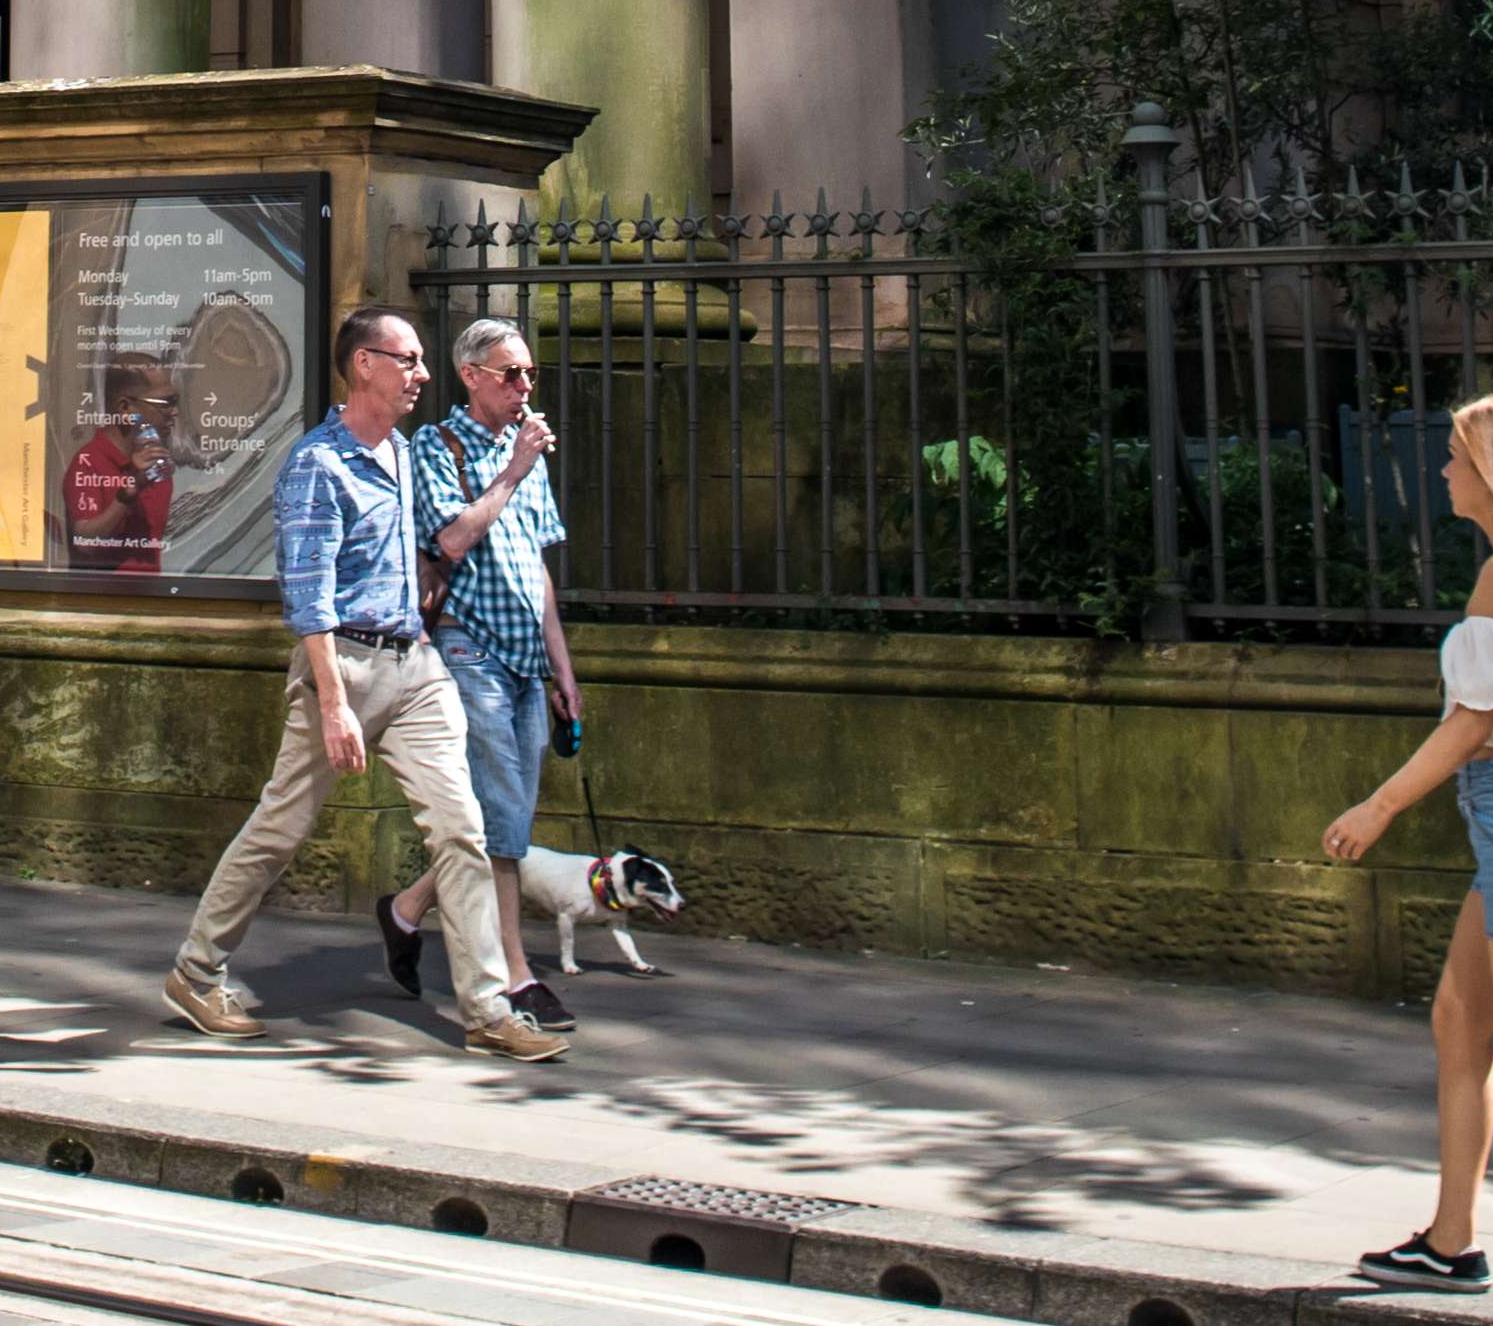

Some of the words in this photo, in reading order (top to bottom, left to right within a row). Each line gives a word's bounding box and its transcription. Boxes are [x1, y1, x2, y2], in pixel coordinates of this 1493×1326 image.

[78, 232, 108, 248] Free
[112, 230, 140, 247] and
[144, 232, 183, 250] open
[187, 231, 203, 246] to
[207, 229, 224, 246] all
[78, 269, 129, 287] Monday
[203, 268, 272, 286] 11am-5pm
[202, 291, 274, 308] 10am-5pm
[97, 325, 152, 338] Wednesday
[153, 324, 165, 336] of
[76, 410, 137, 426] Entrance
[200, 435, 265, 452] Entrance
[22, 442, 31, 495] Manchester
[75, 472, 136, 489] Entrance
[73, 535, 124, 548] Manchester
[124, 537, 139, 548] Art
[140, 537, 172, 554] Gallery
